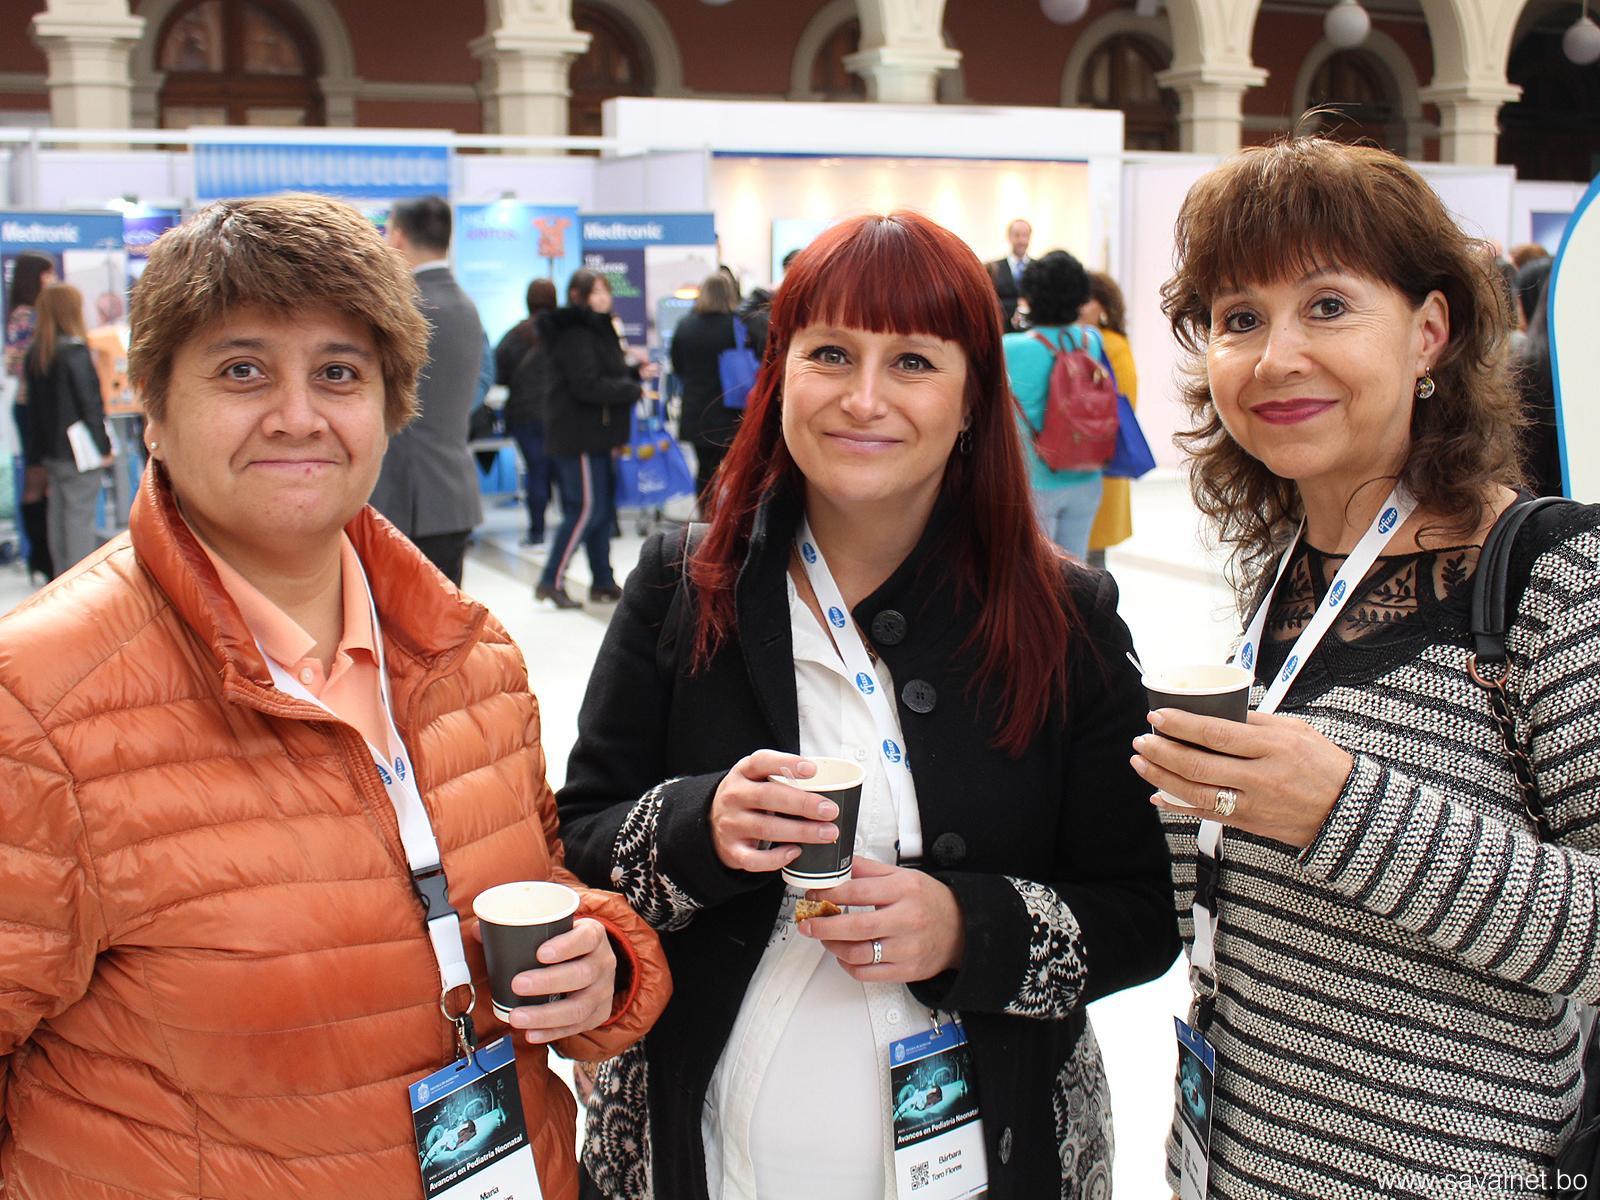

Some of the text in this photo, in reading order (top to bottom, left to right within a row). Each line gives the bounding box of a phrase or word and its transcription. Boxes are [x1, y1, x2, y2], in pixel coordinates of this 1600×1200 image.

[2, 222, 79, 243] Medtronic
[583, 222, 663, 240] Medtronic
[1377, 507, 1398, 534] Pfizer
[1329, 580, 1347, 607] Pfizer
[1281, 655, 1299, 682] Pfizer
[855, 672, 875, 695] Pfizer
[882, 739, 902, 763] Pfizer
[897, 1130, 922, 1144] Avances
[923, 1126, 932, 1135] en
[955, 1106, 979, 1123] Neonatal
[429, 1171, 457, 1191] Avances
[457, 1167, 467, 1176] en
[494, 1133, 523, 1154] Neonatal
